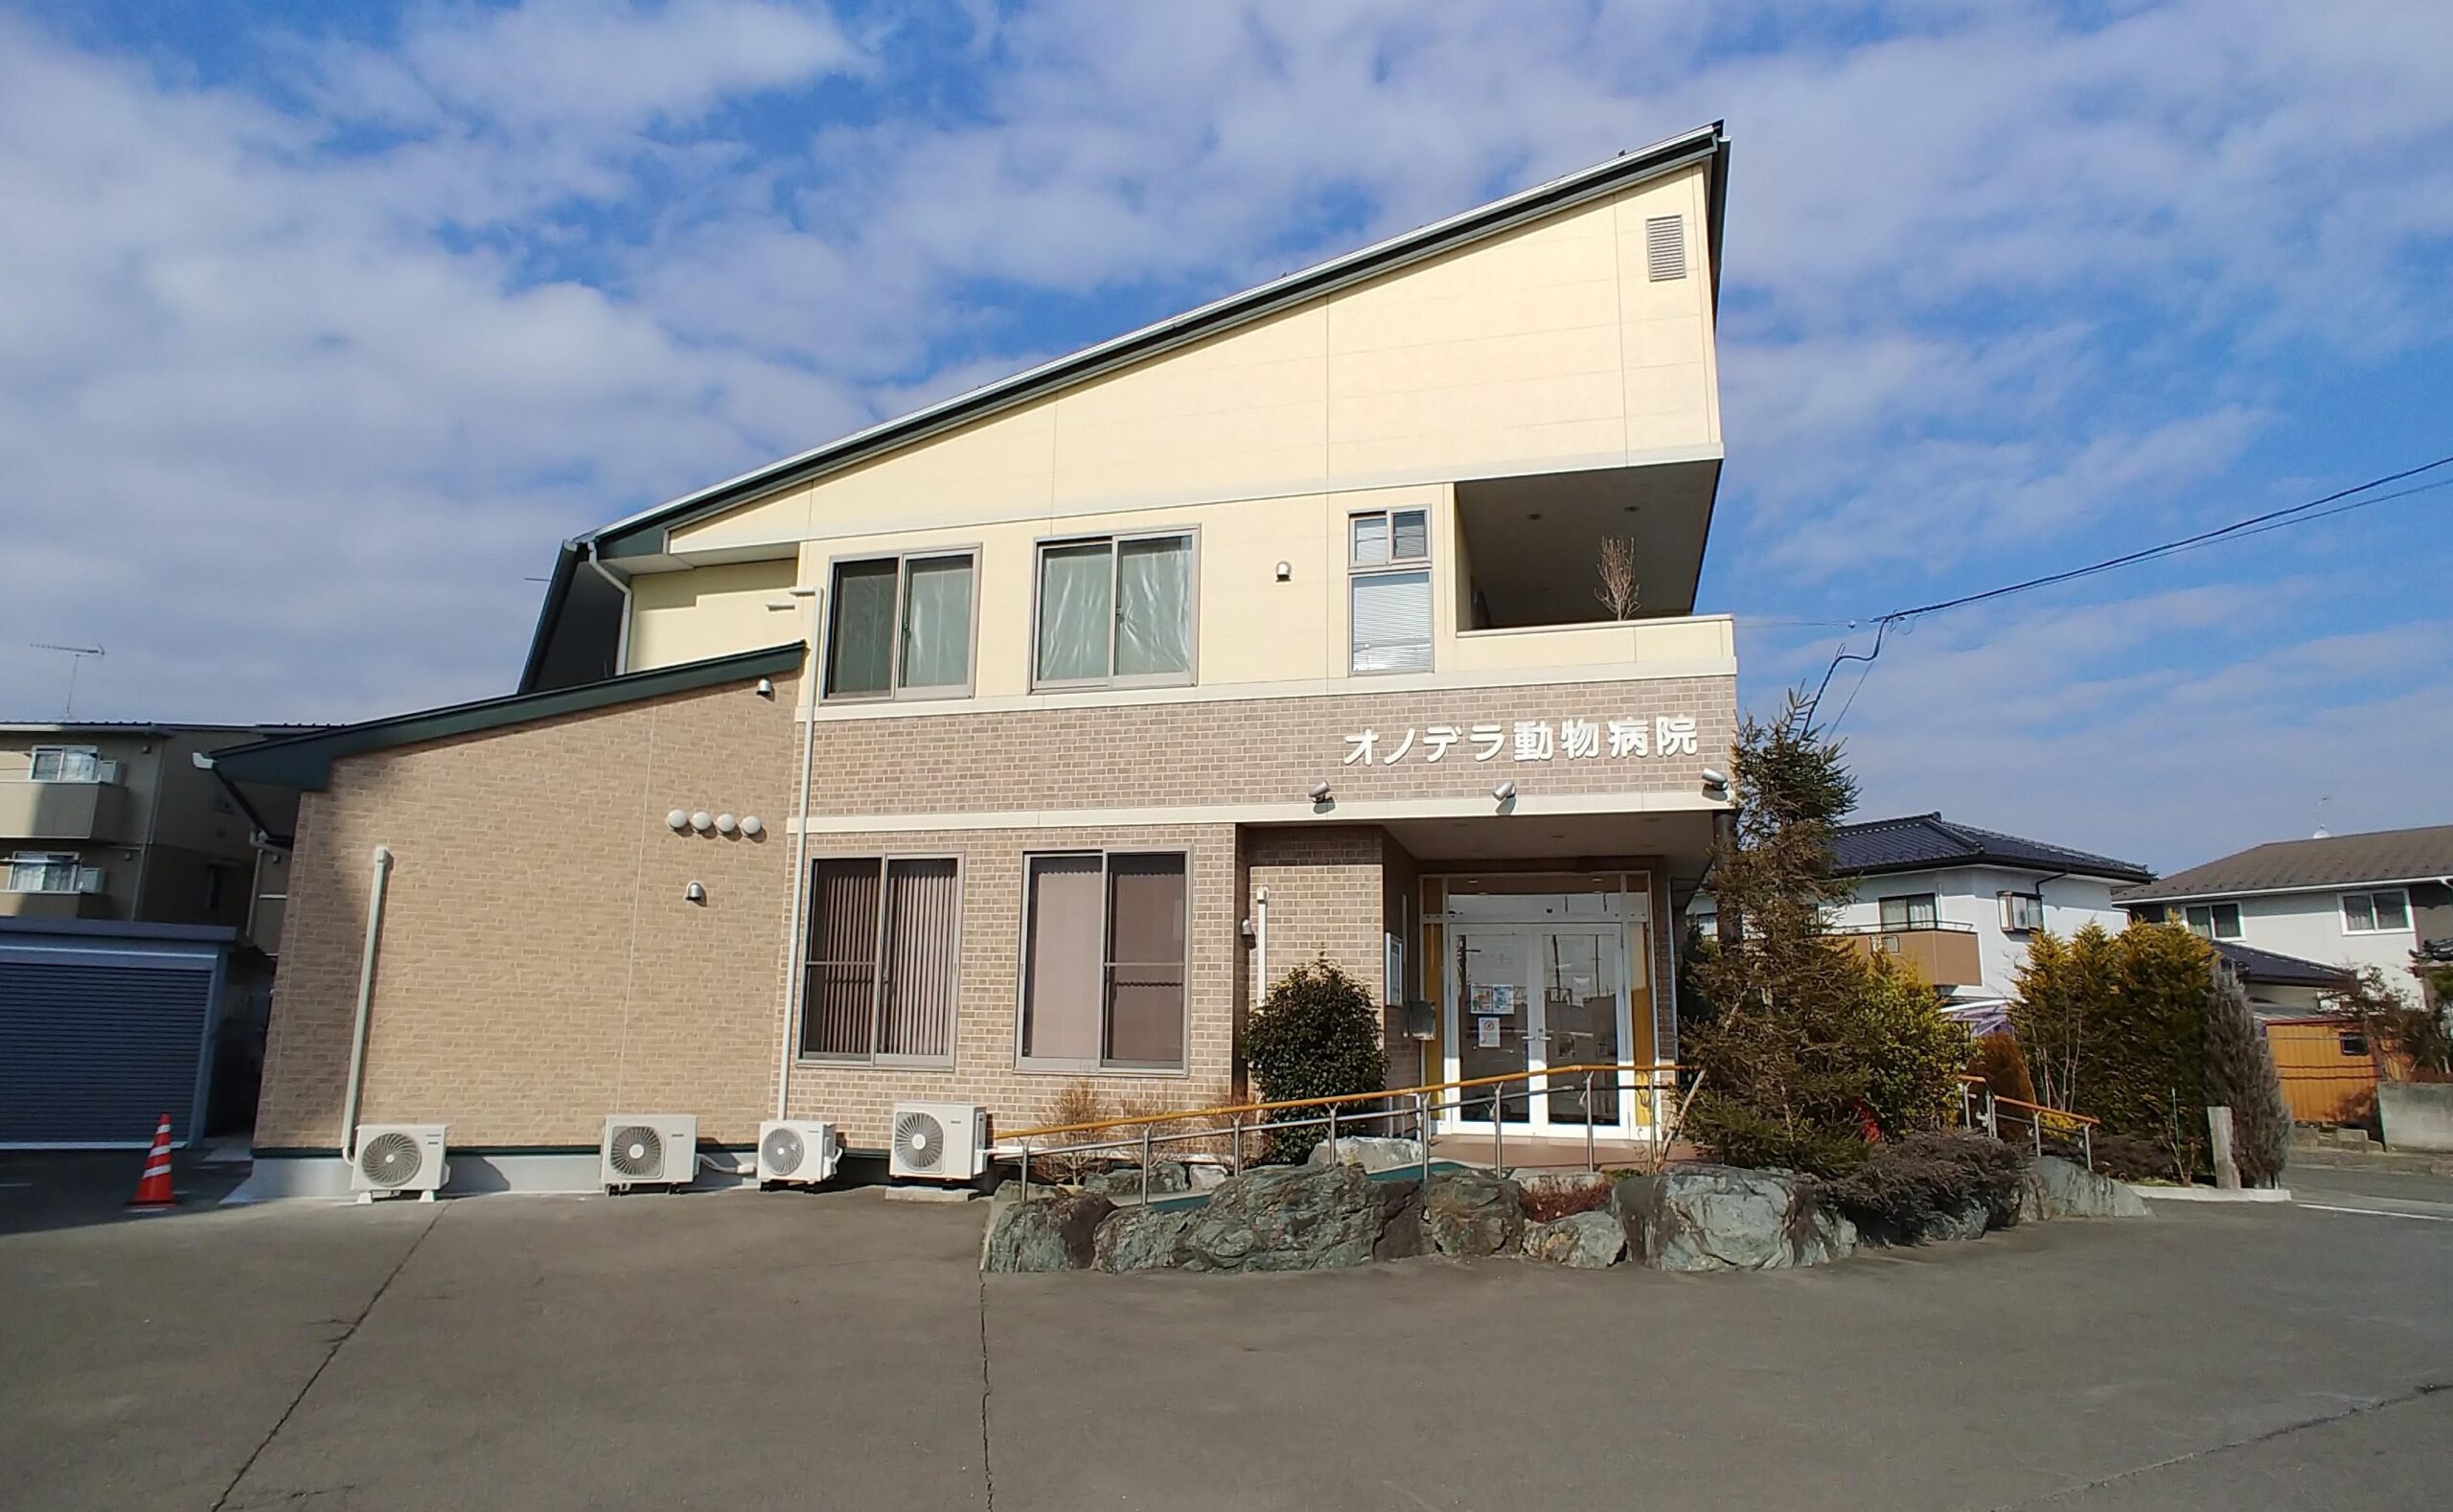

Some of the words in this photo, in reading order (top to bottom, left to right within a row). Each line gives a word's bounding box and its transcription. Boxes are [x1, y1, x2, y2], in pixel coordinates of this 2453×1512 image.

[1343, 714, 1698, 766] オノデラ動物病院
